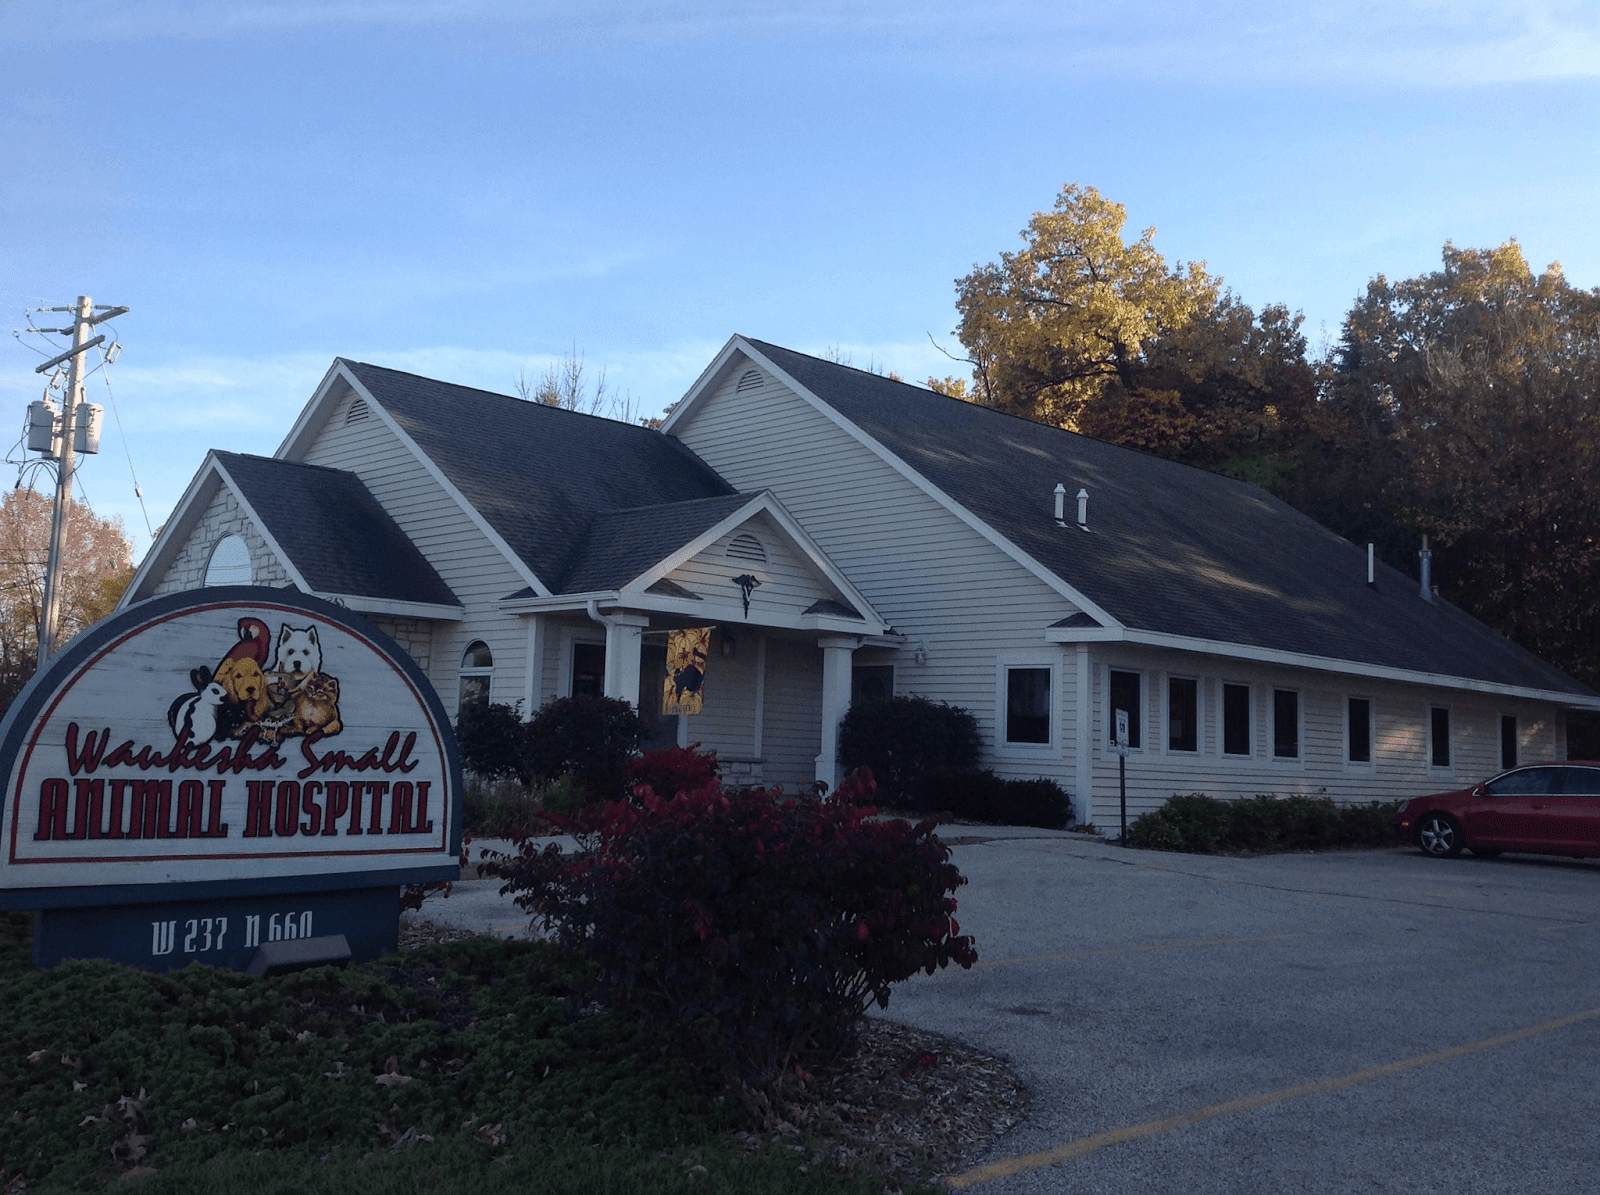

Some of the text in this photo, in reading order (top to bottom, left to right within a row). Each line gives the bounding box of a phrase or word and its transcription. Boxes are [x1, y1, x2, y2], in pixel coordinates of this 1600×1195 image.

[66, 722, 419, 779] Waukesha Small
[33, 778, 433, 840] ANIMAL HOSPITAL
[184, 917, 228, 953] 237
